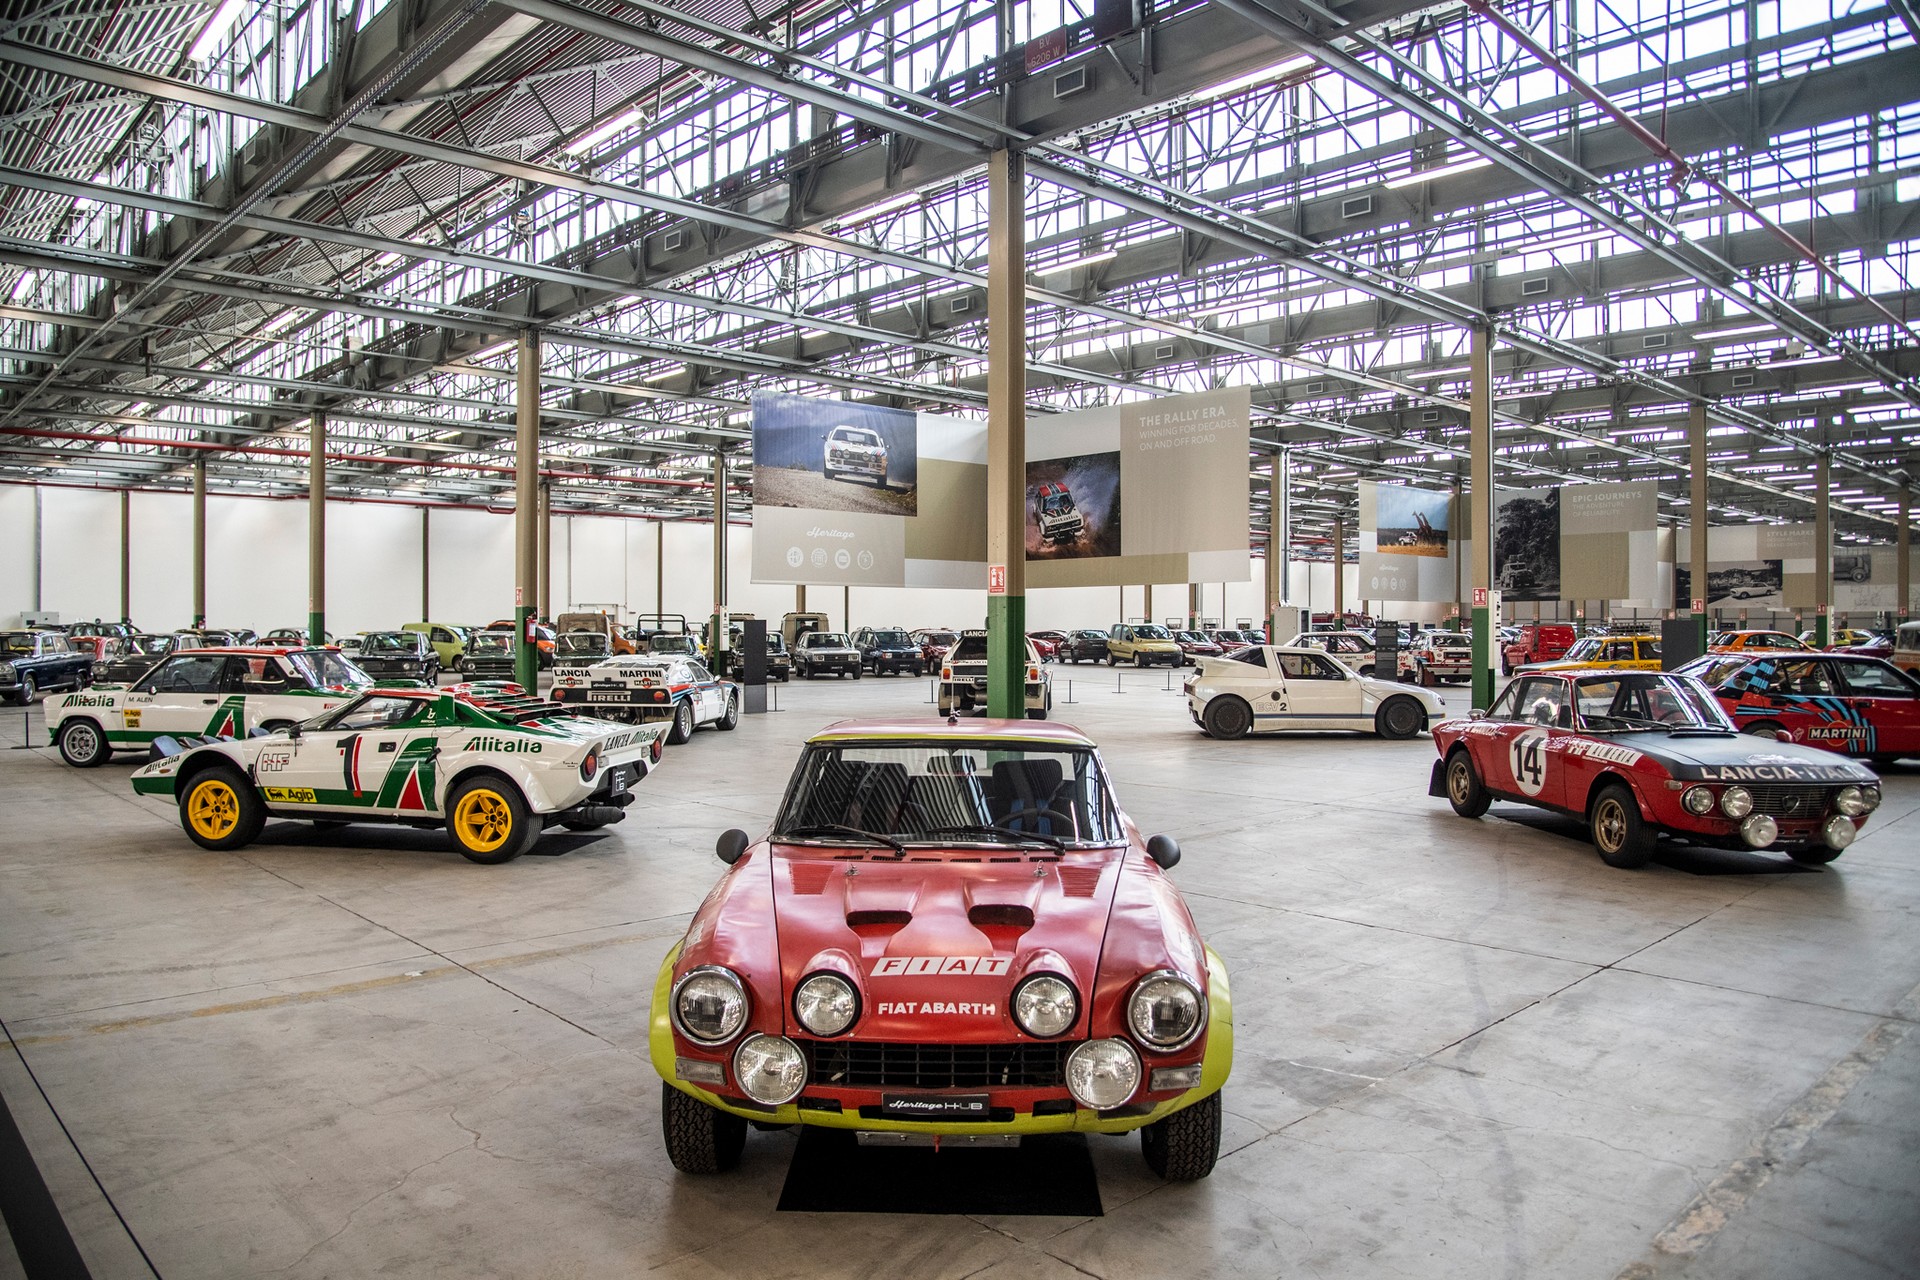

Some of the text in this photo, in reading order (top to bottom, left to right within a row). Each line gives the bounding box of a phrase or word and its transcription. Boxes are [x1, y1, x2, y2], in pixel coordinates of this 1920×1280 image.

[1139, 405, 1226, 428] THE RALLY ERA
[1139, 418, 1240, 439] WINNING FOR DECADES,
[1140, 441, 1153, 451] ON
[1154, 439, 1173, 449] AND
[1173, 437, 1190, 446] OFF
[1572, 490, 1642, 503] EPIC JOURNEYS
[806, 526, 855, 540] Heritage
[554, 669, 662, 678] LANCIA MARTINI
[61, 694, 115, 708] Alitalia
[586, 690, 632, 702] PIRELLI
[1256, 702, 1287, 712] ECV 2
[1810, 728, 1867, 739] MARTINI
[462, 736, 543, 753] Alitalia
[602, 732, 631, 752] LANCIA
[143, 755, 180, 775] Alitalia
[261, 753, 291, 772] HF
[336, 733, 363, 798] 1
[1513, 734, 1542, 787] 14
[287, 788, 315, 802] Agip
[876, 957, 1009, 975] FIAT
[878, 1002, 996, 1016] FIAT ABARTH
[888, 1099, 983, 1111] Heritage HUB
